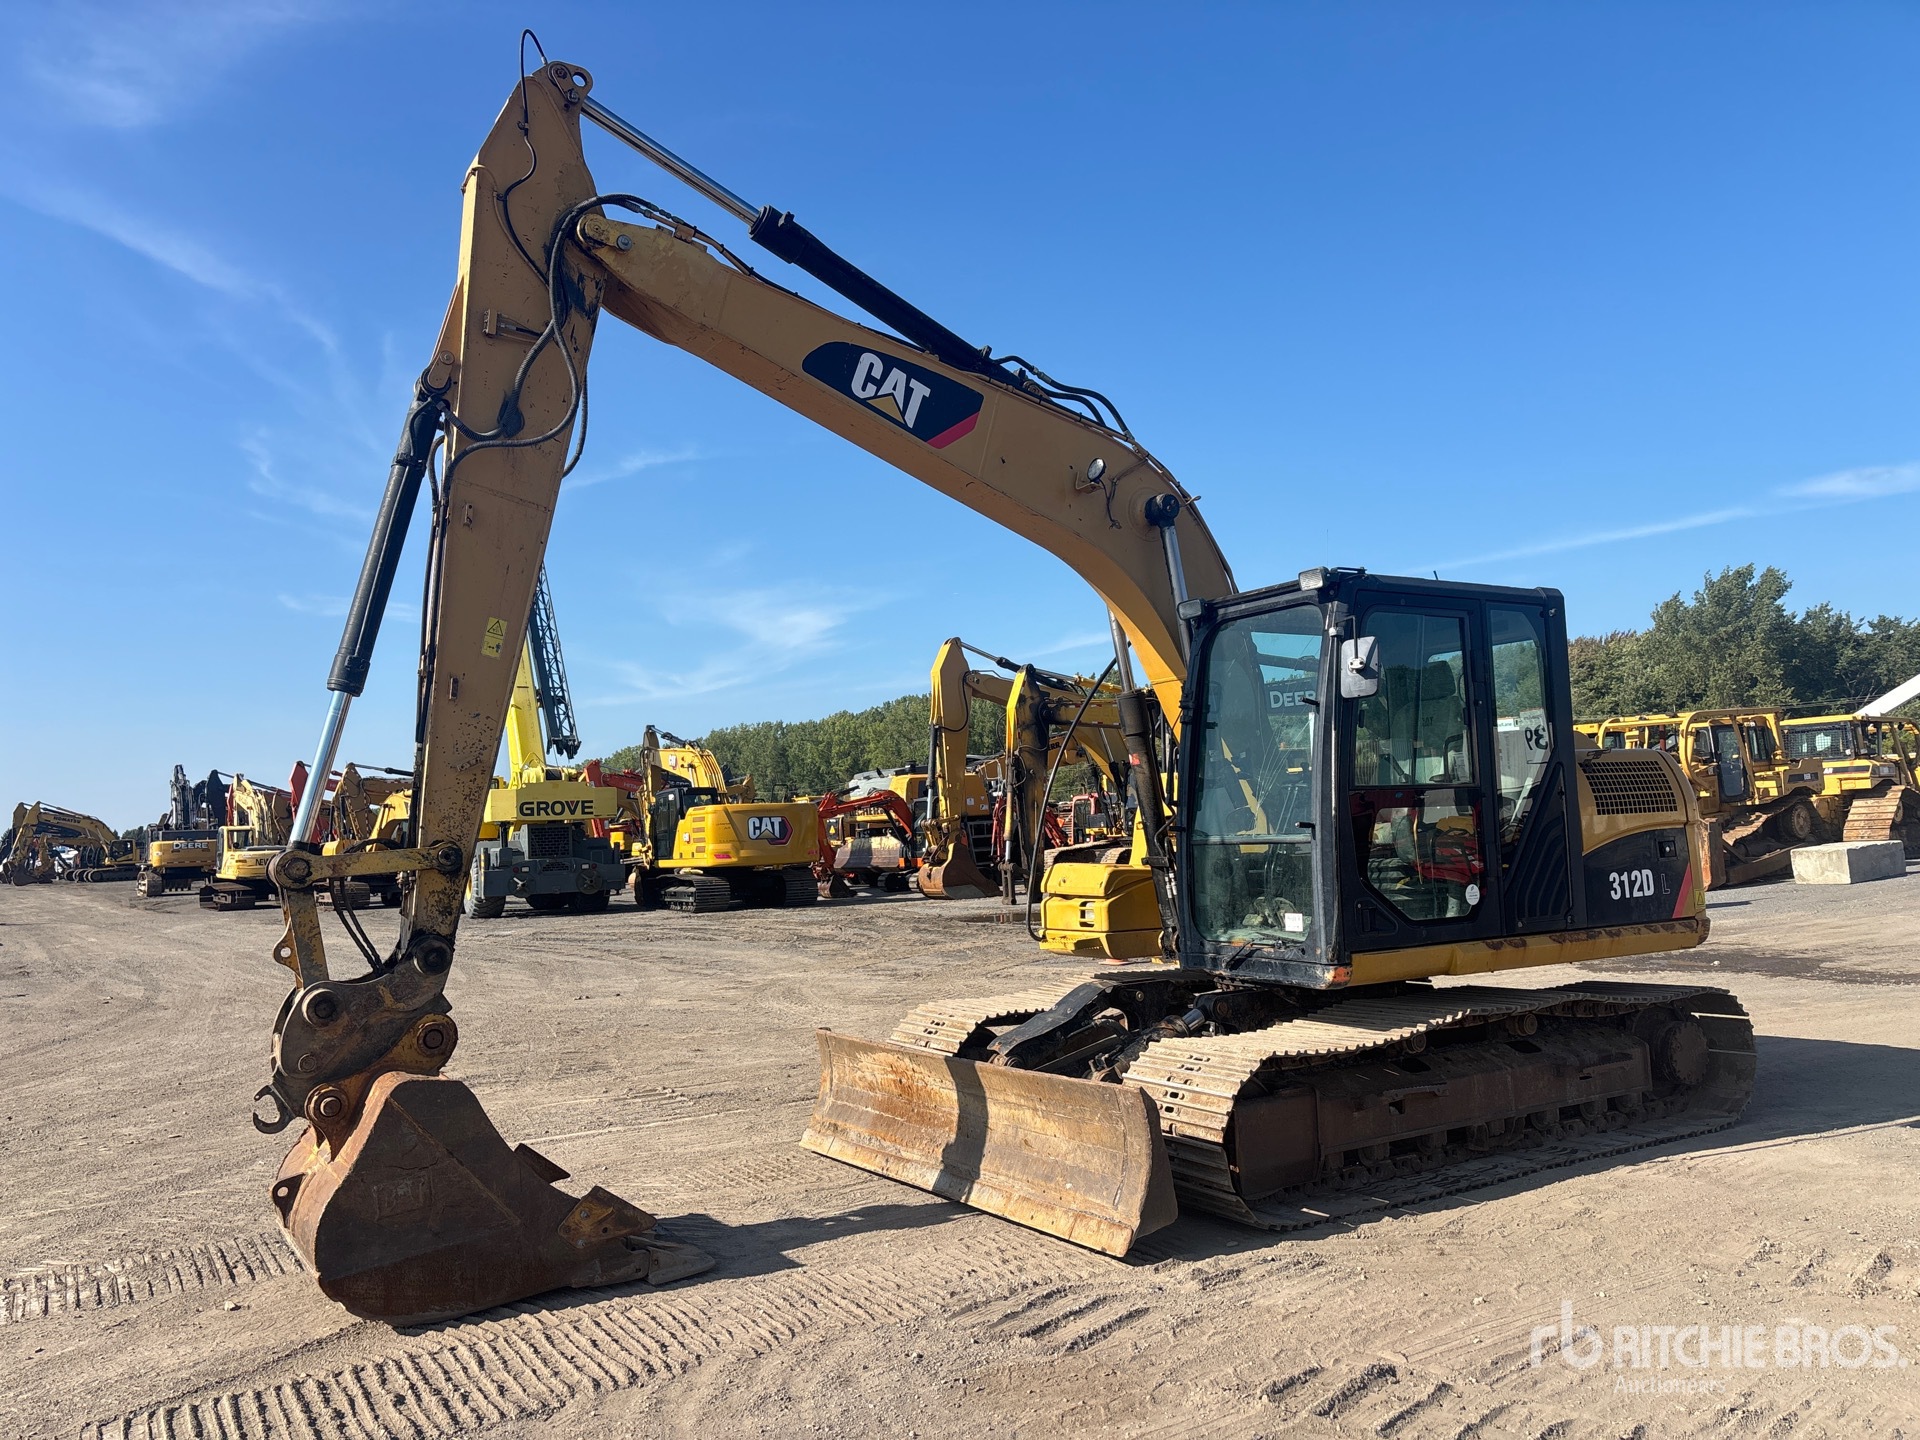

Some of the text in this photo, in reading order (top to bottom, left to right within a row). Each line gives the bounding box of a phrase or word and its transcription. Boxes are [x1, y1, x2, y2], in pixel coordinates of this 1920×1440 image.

[851, 352, 931, 429] CAT
[519, 800, 594, 817] GROVE
[53, 816, 81, 824] KOMATSU
[748, 816, 782, 840] CAT
[173, 842, 209, 850] DEERE
[1609, 869, 1671, 900] 312D L
